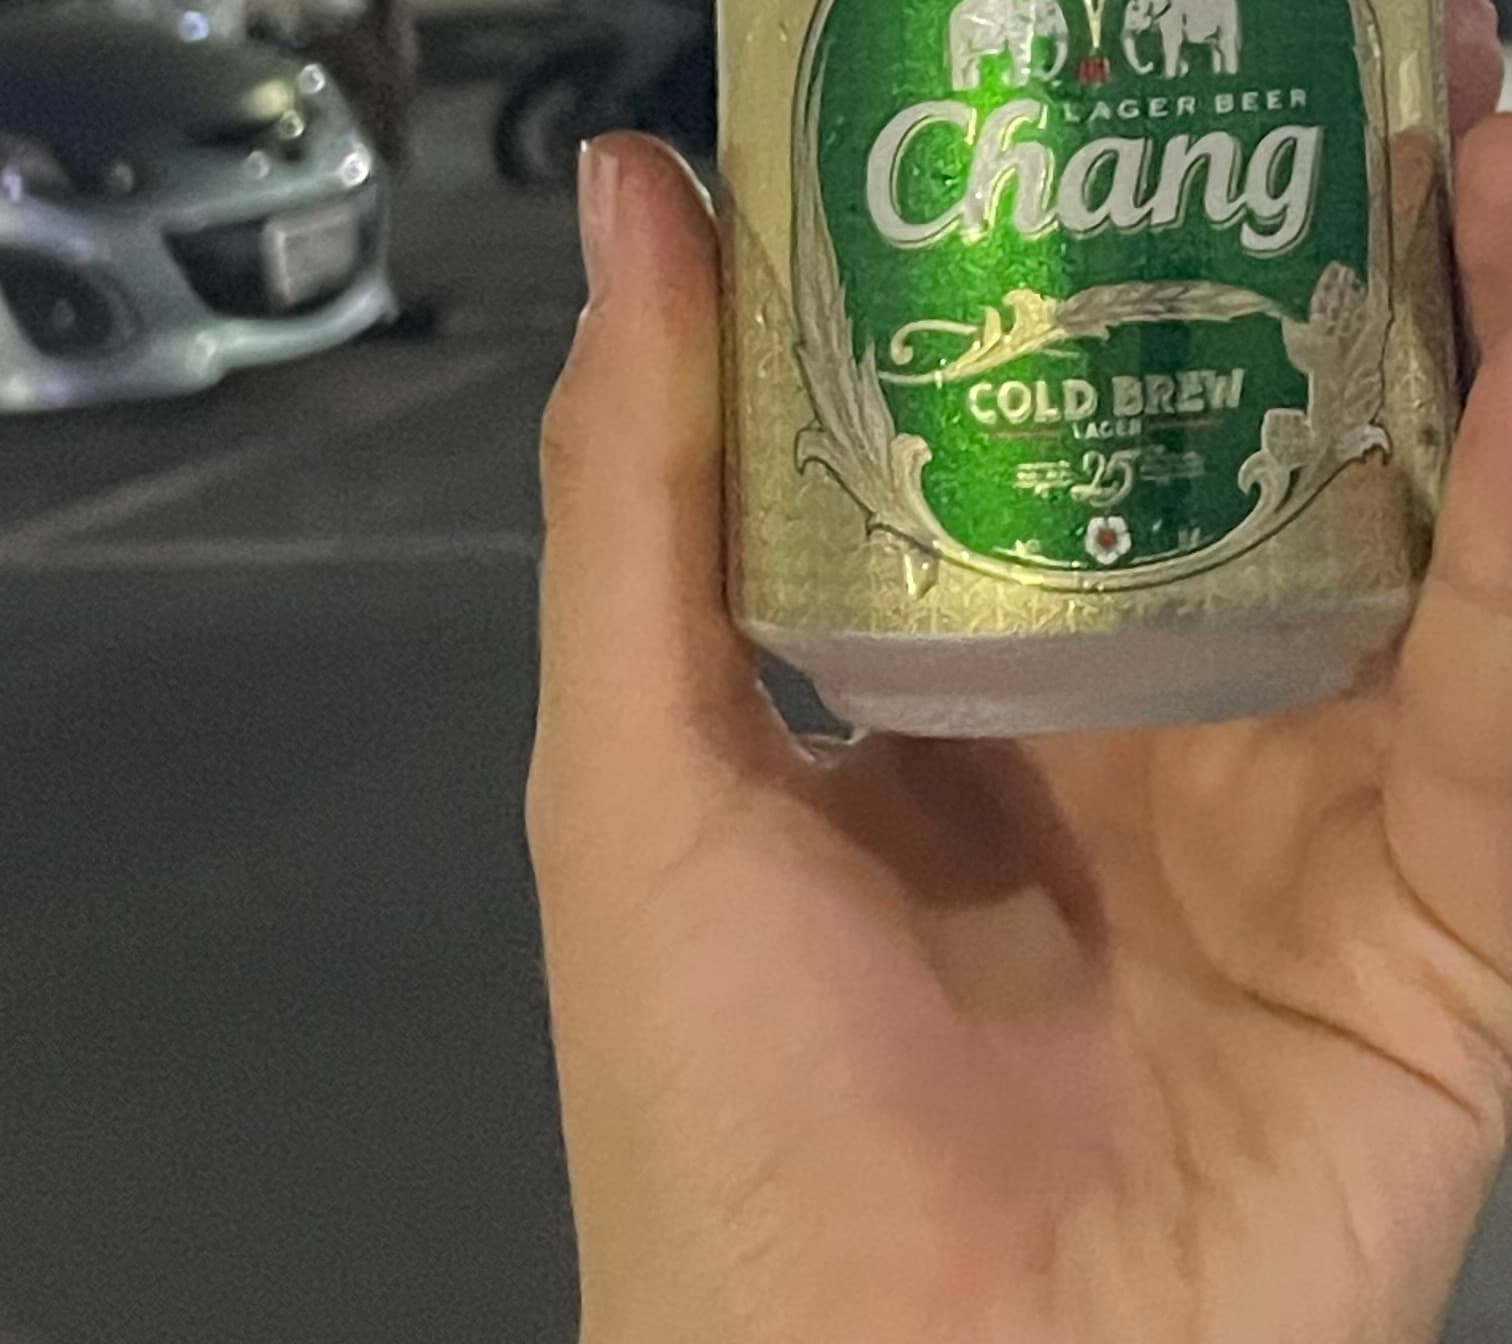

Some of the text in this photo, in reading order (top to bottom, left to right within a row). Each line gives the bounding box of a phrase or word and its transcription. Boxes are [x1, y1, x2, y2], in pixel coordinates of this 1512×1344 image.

[1063, 87, 1308, 125] LAGER BEER
[865, 98, 1325, 257] Chang
[967, 367, 1246, 426] COLD BREW
